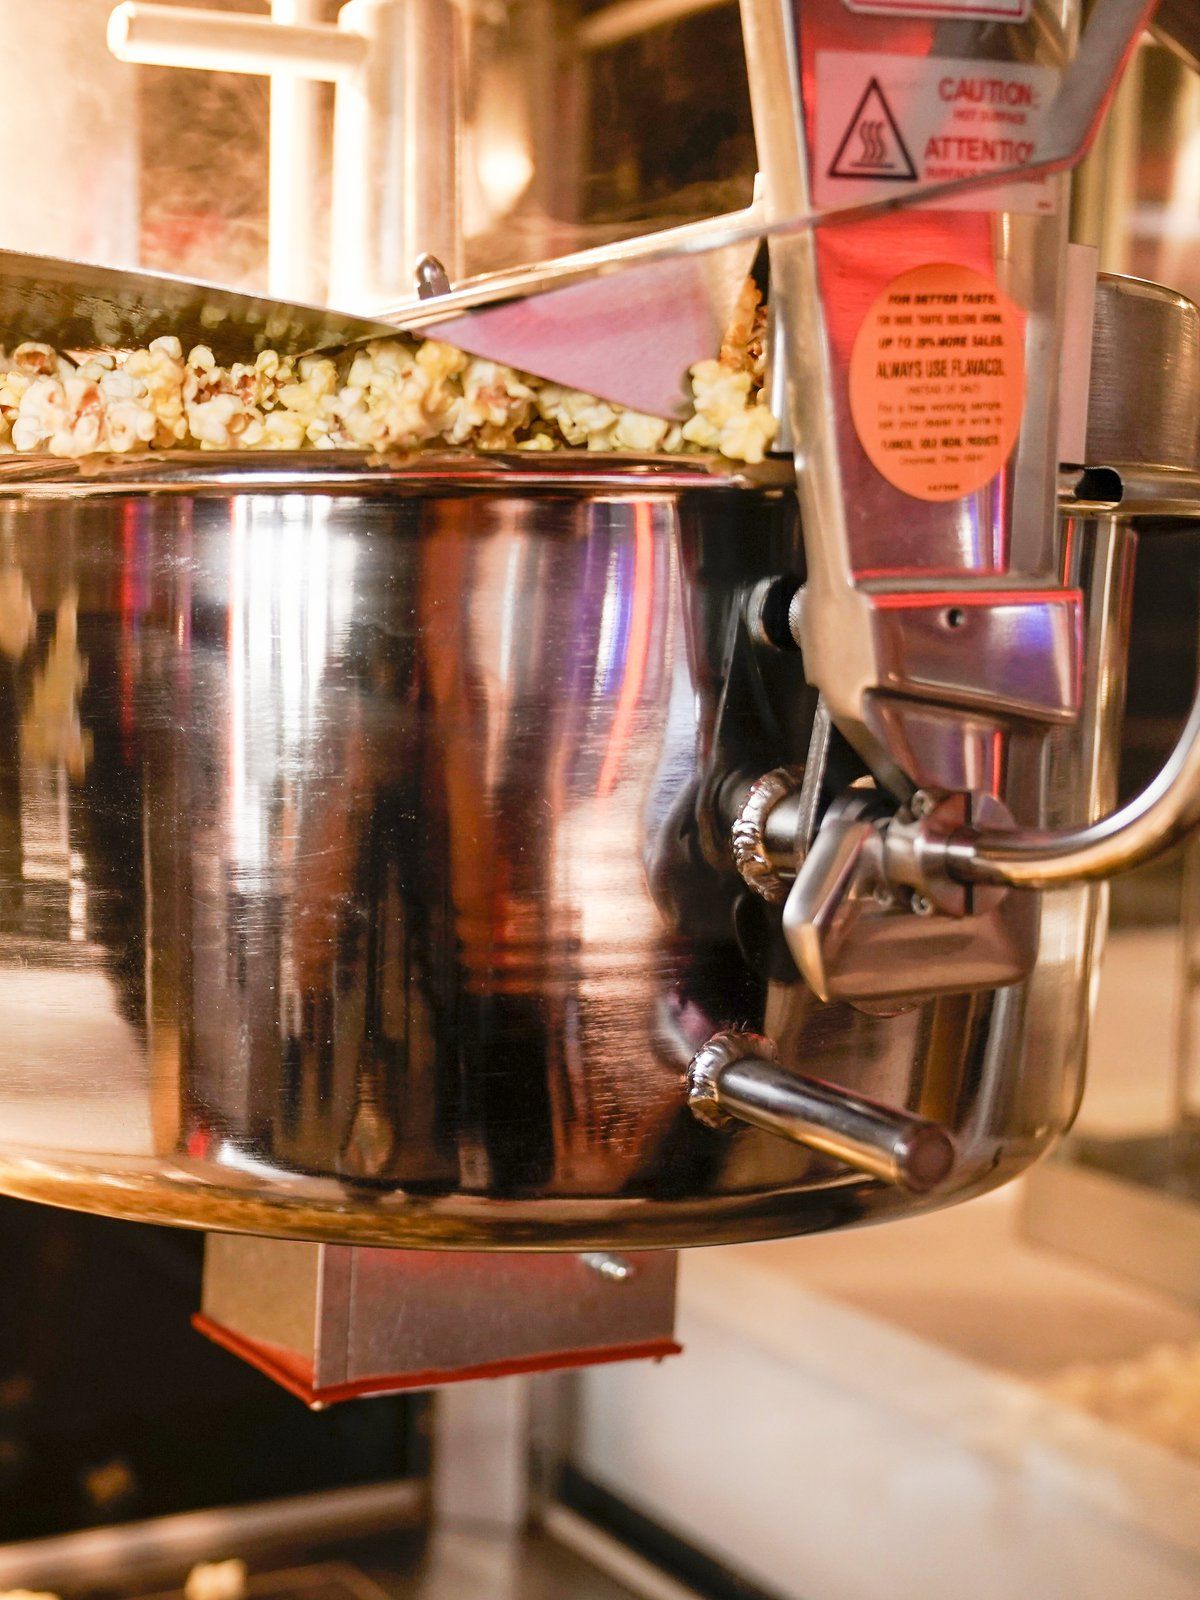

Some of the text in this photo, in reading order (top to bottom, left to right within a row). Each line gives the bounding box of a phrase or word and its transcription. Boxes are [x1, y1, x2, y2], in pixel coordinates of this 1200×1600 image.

[888, 294, 910, 305] FOR
[914, 294, 957, 305] BETTER
[878, 338, 892, 349] UP
[898, 338, 912, 349] TO
[937, 336, 967, 348] MORE
[876, 359, 1005, 379] ALWAYS USE FLAVACOL
